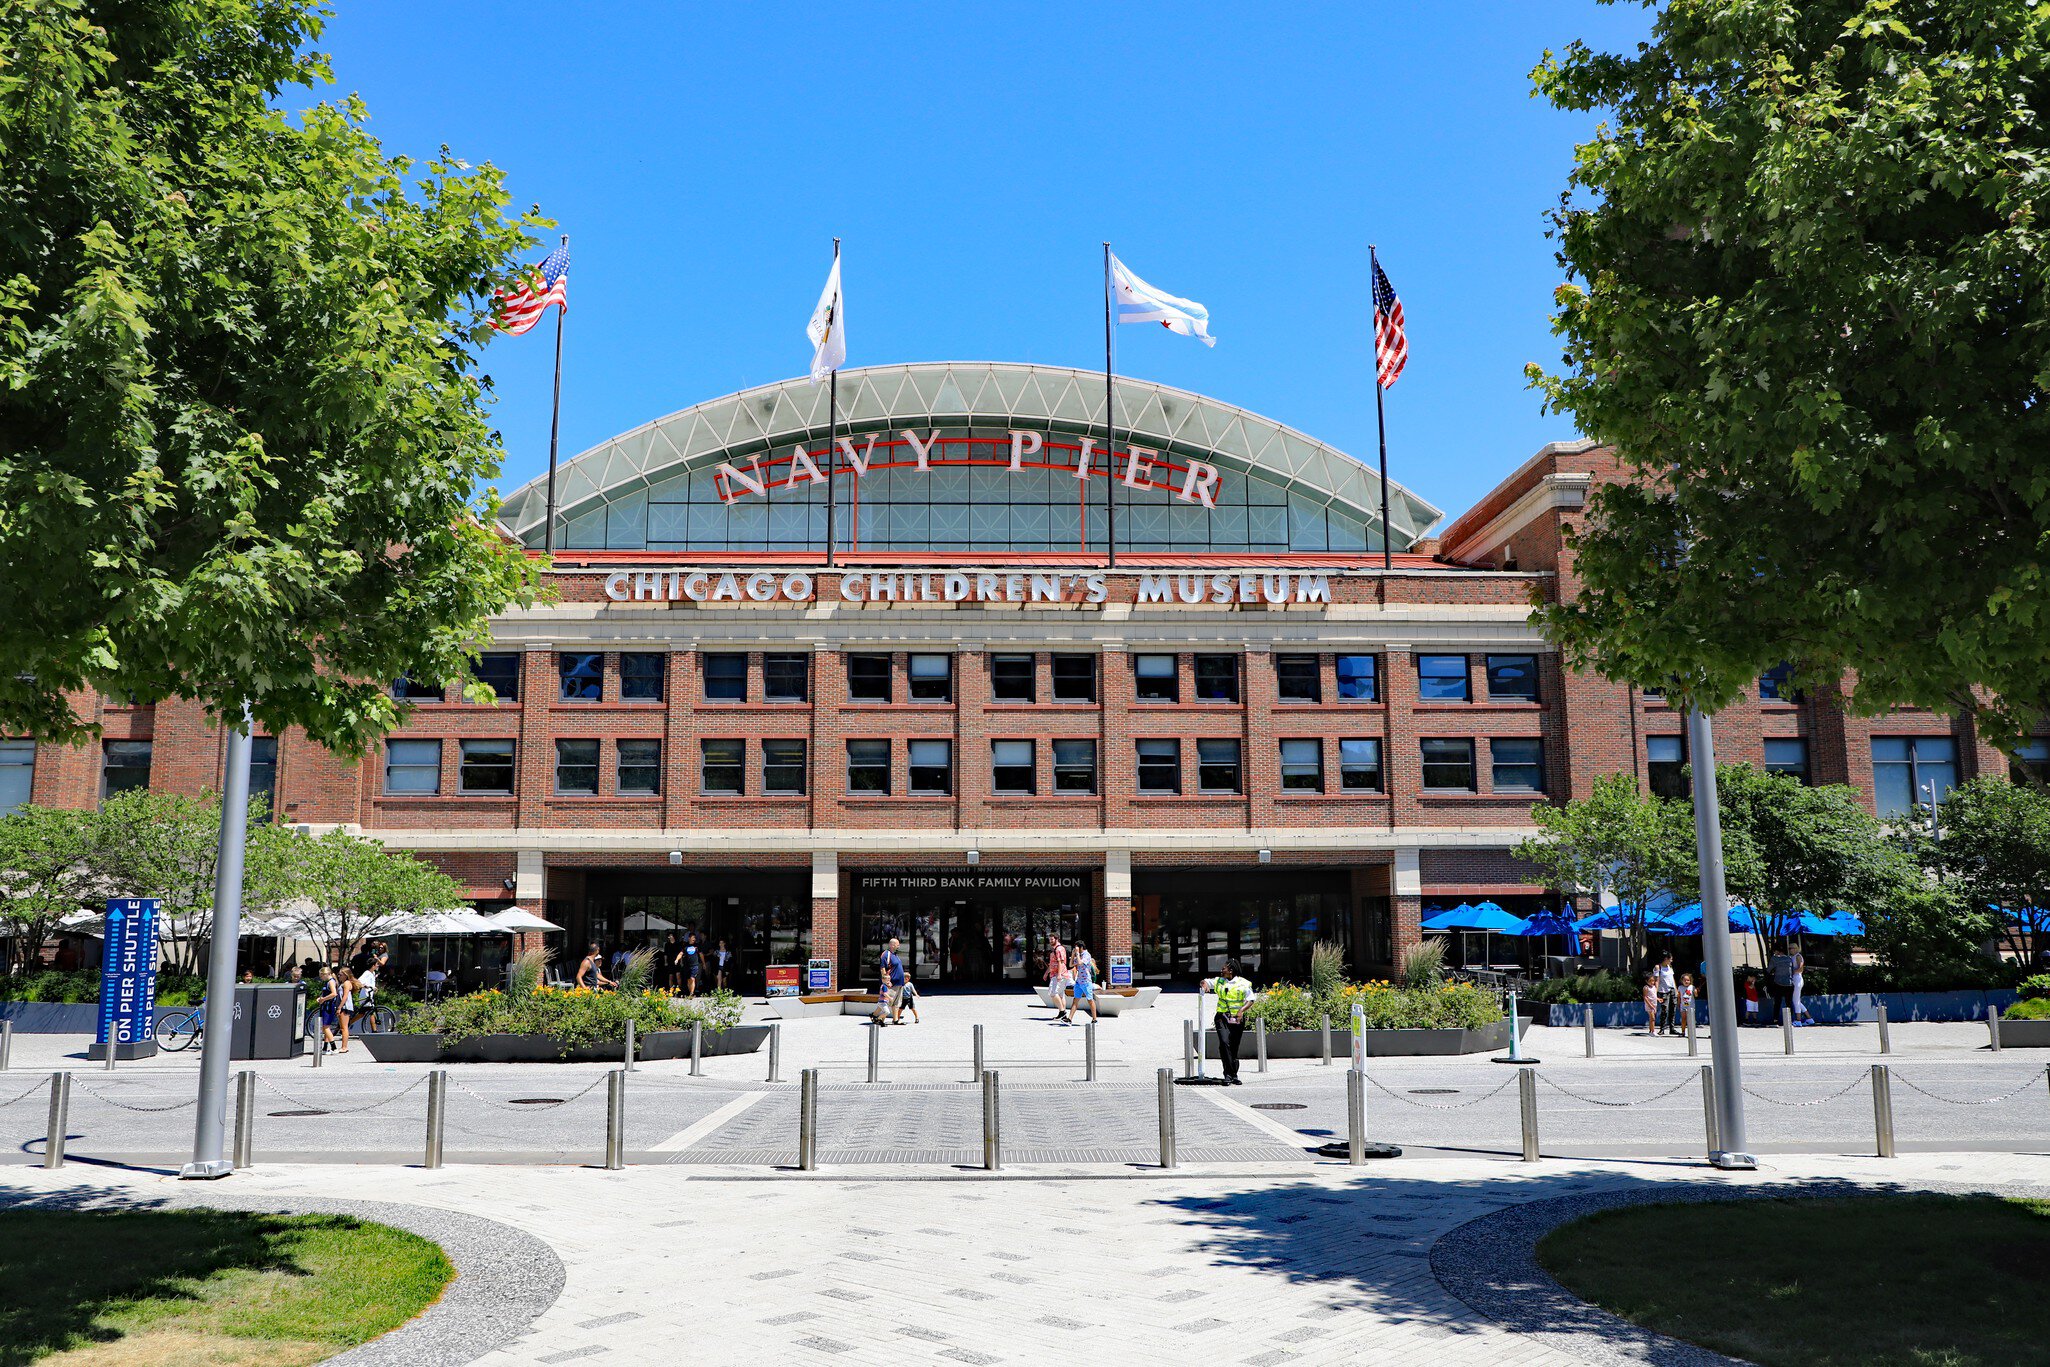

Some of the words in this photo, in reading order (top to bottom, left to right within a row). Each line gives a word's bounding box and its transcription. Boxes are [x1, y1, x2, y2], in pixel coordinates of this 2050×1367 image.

[714, 429, 941, 506] NAVY
[1005, 430, 1217, 510] PIER
[604, 571, 814, 602] CHICAGO
[839, 571, 1109, 604] CHILDREN'S
[1137, 573, 1333, 604] MUSEUM
[862, 877, 897, 888] FIFTH
[900, 877, 937, 888] THIRD
[940, 877, 975, 888] BANK
[978, 877, 1022, 888] FAMILY
[1025, 877, 1081, 888] PAVILION
[123, 900, 141, 972] SHUTTLE
[148, 900, 161, 971] SHUTTLE
[120, 977, 135, 1013] PIER
[145, 976, 155, 1011] PIER
[118, 1018, 132, 1041] ON
[144, 1016, 153, 1039] ON
